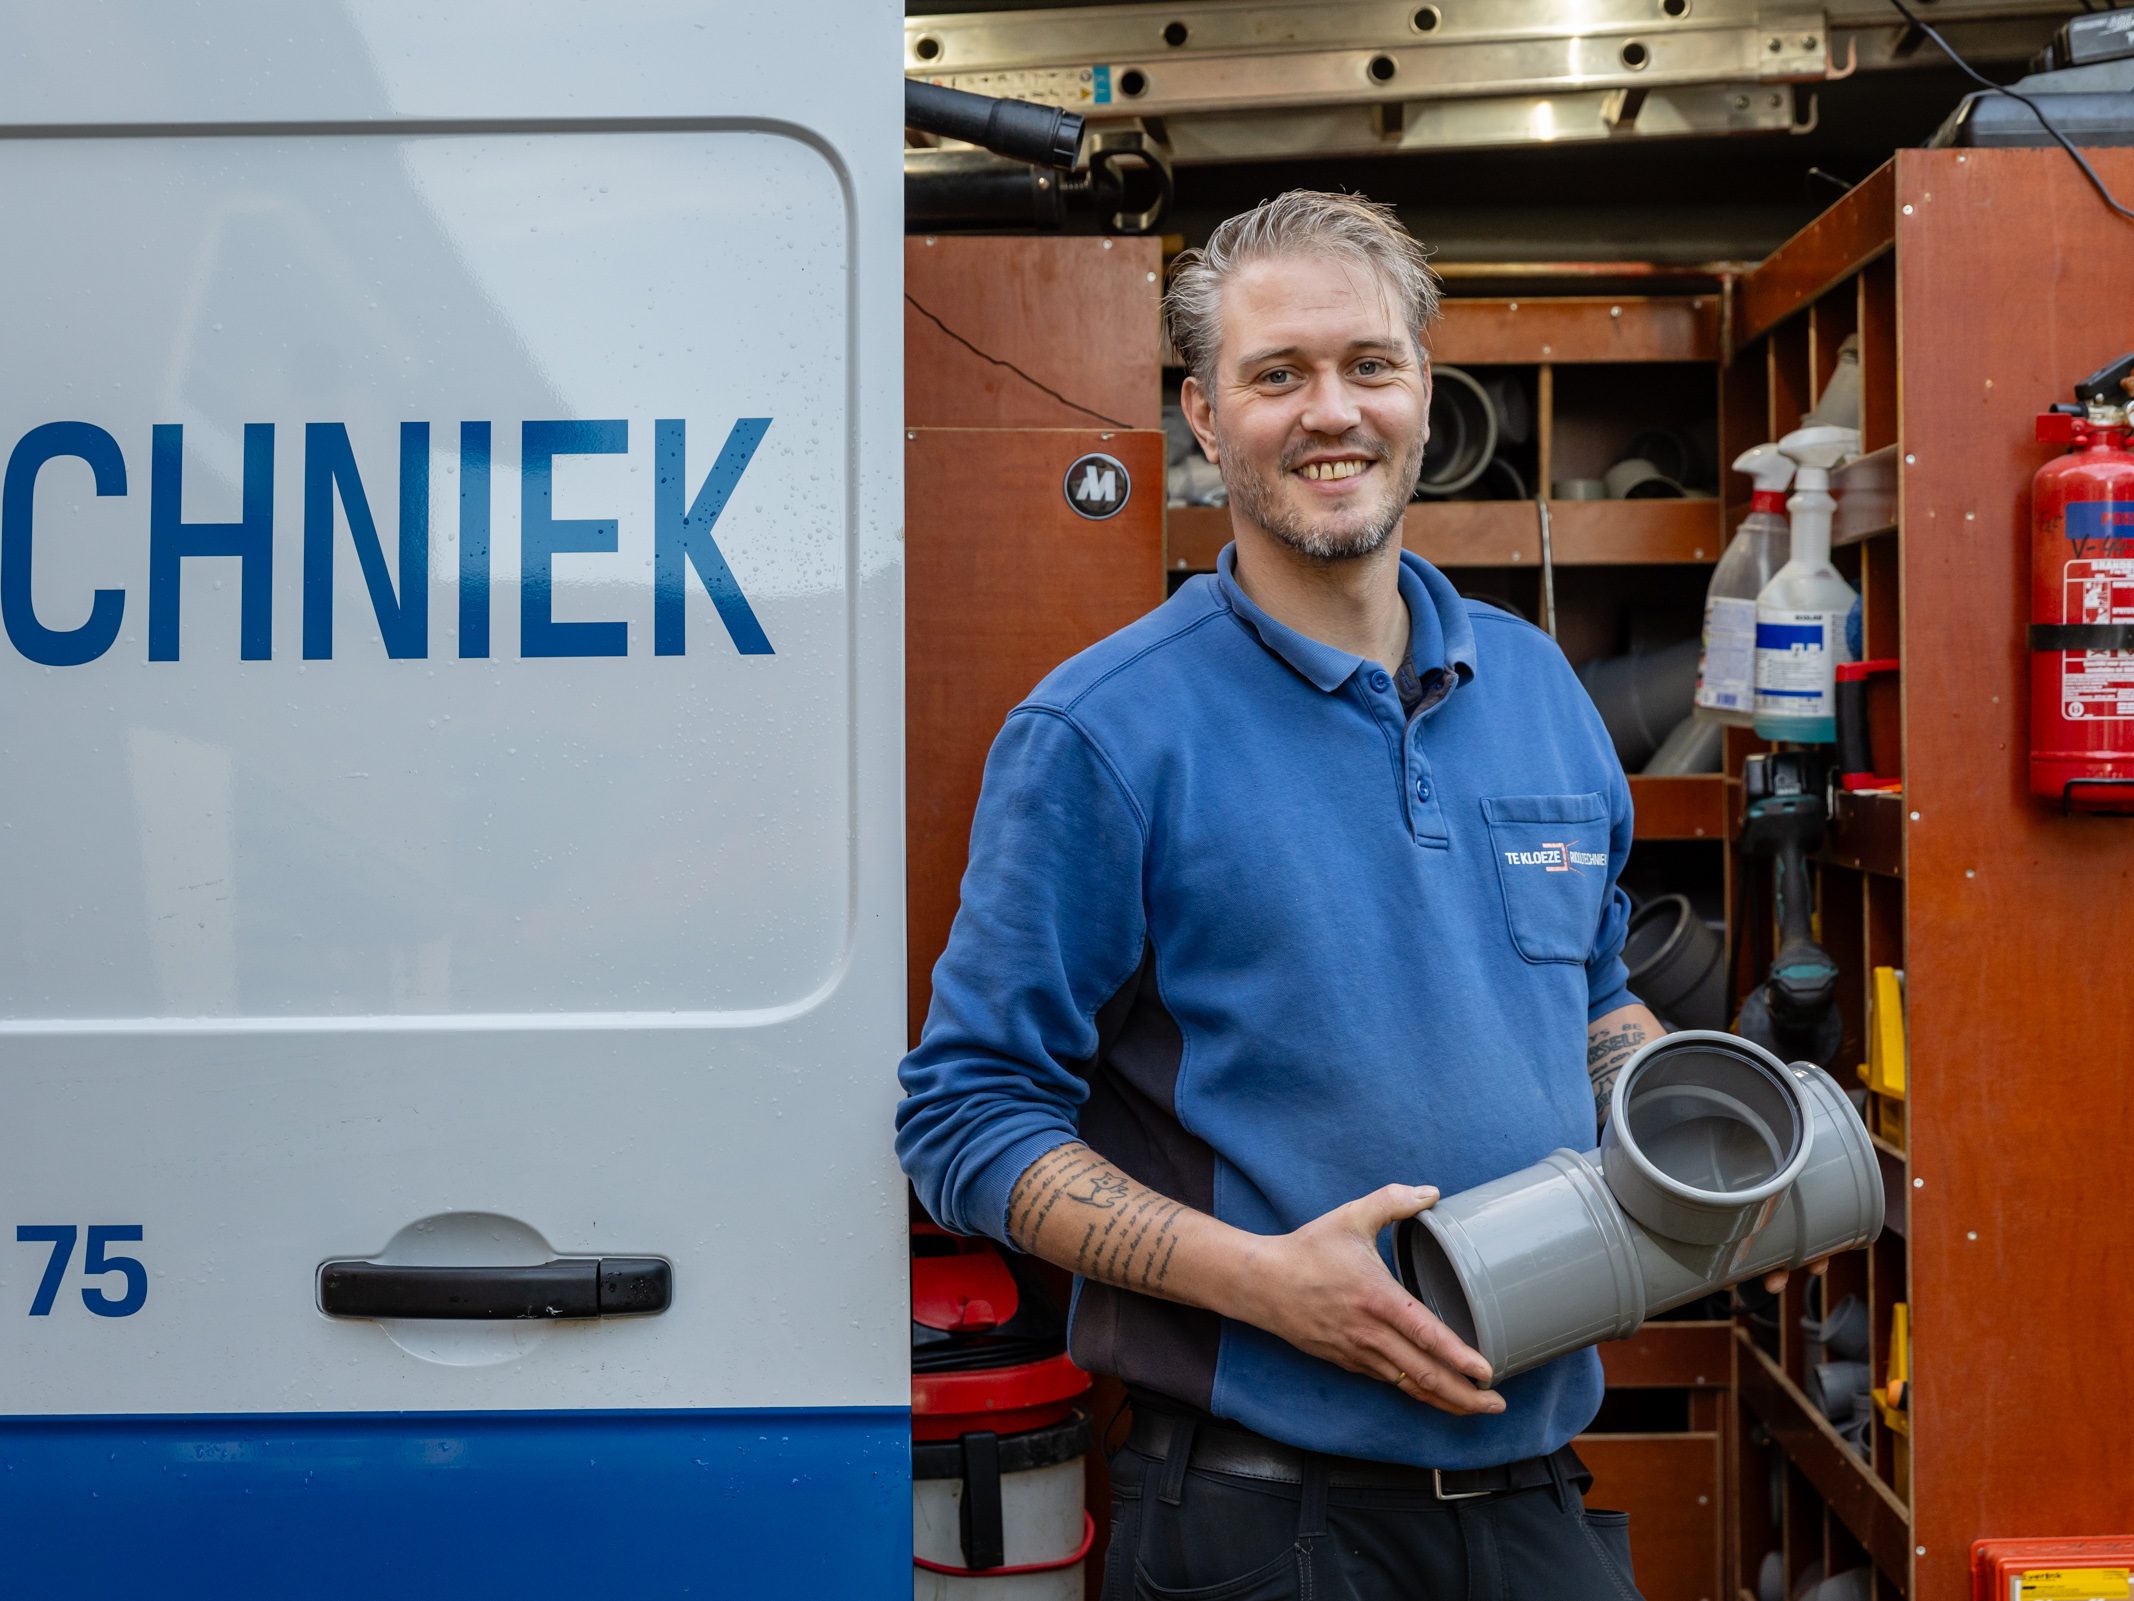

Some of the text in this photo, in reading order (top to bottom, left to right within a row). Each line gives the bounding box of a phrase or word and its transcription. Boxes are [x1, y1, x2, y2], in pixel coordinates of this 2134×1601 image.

[1, 417, 776, 667] CHNIEK
[1504, 852, 1520, 865] TE
[1520, 850, 1562, 865] KLOEZE
[16, 1224, 148, 1318] 75
